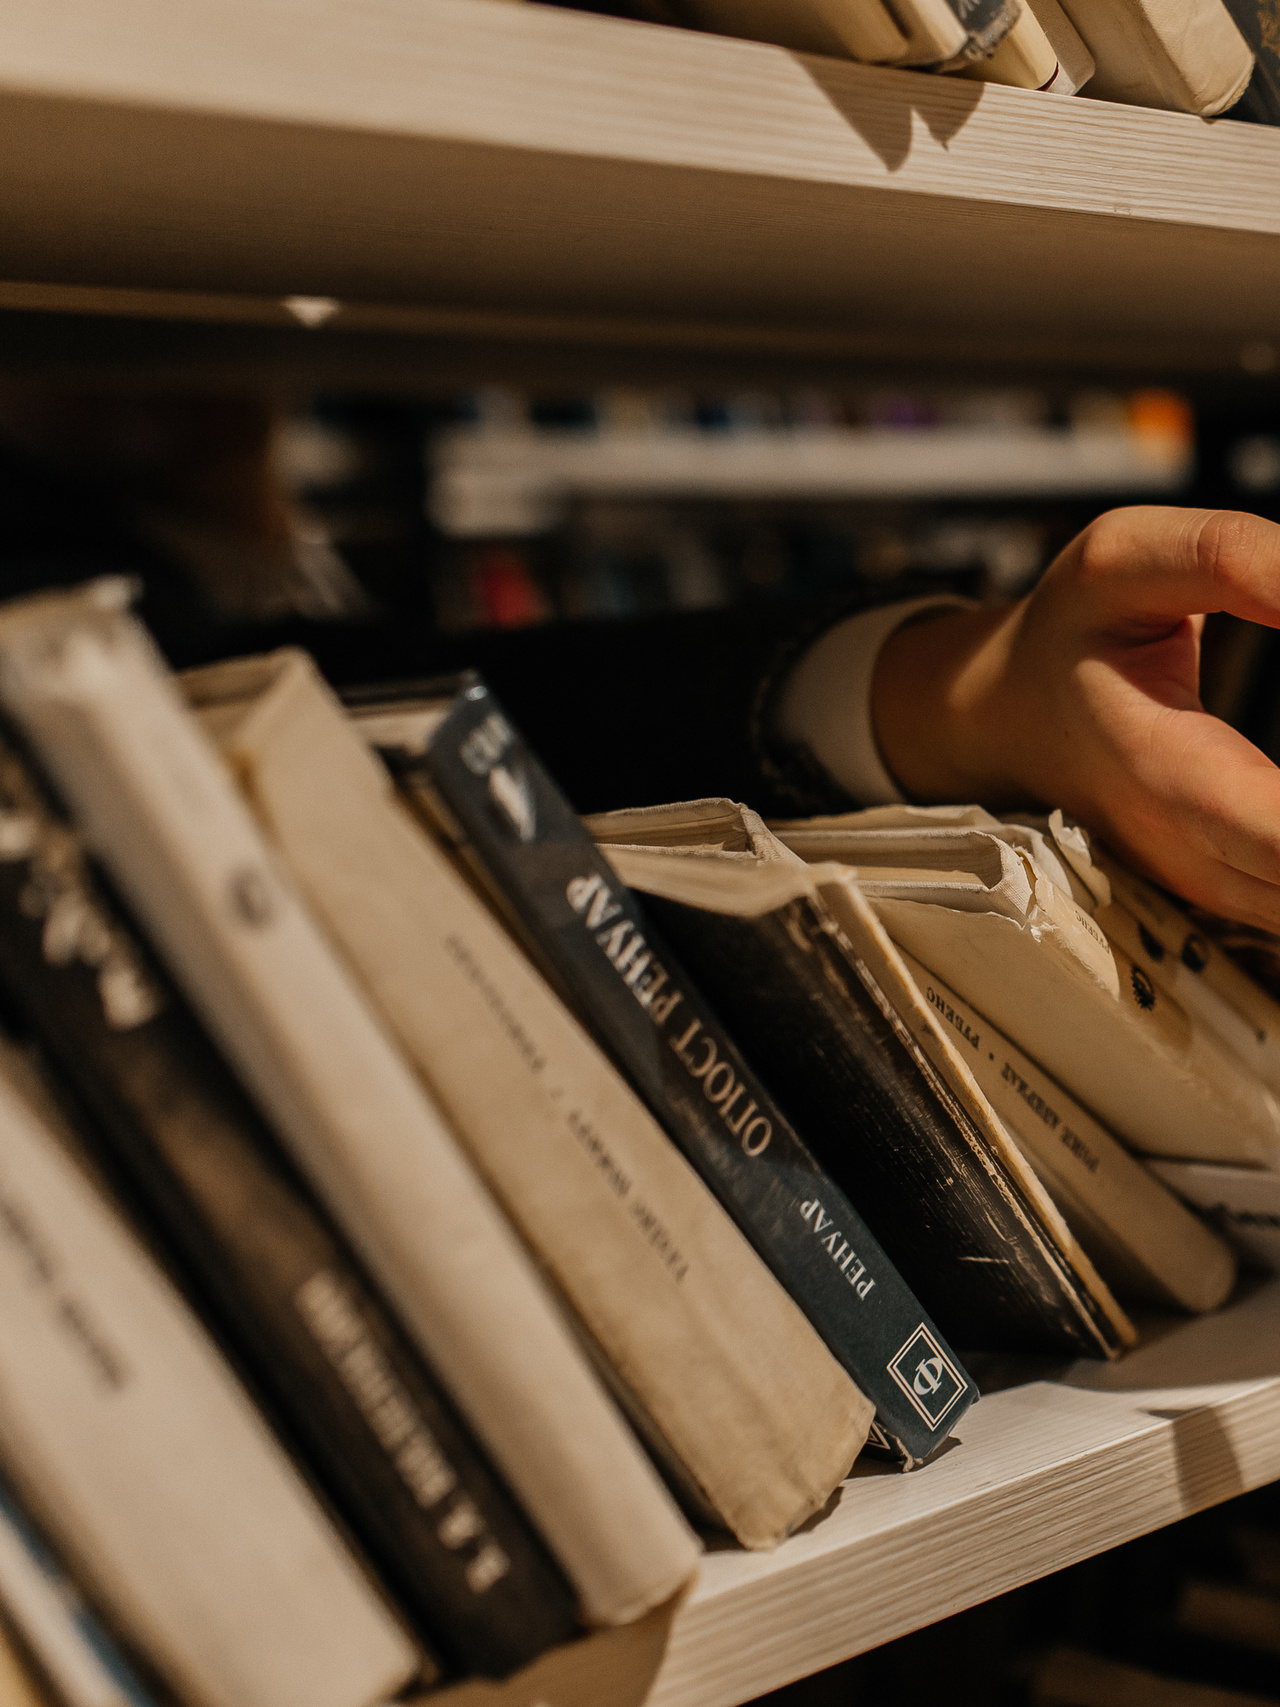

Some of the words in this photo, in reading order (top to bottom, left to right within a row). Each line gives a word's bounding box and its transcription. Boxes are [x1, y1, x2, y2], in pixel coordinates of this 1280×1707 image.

[566, 873, 684, 1027] РЕНУАР
[926, 986, 981, 1050] РУБЕНС
[669, 1018, 772, 1156] ОГЮСТ
[800, 1198, 876, 1301] РЕНУАР
